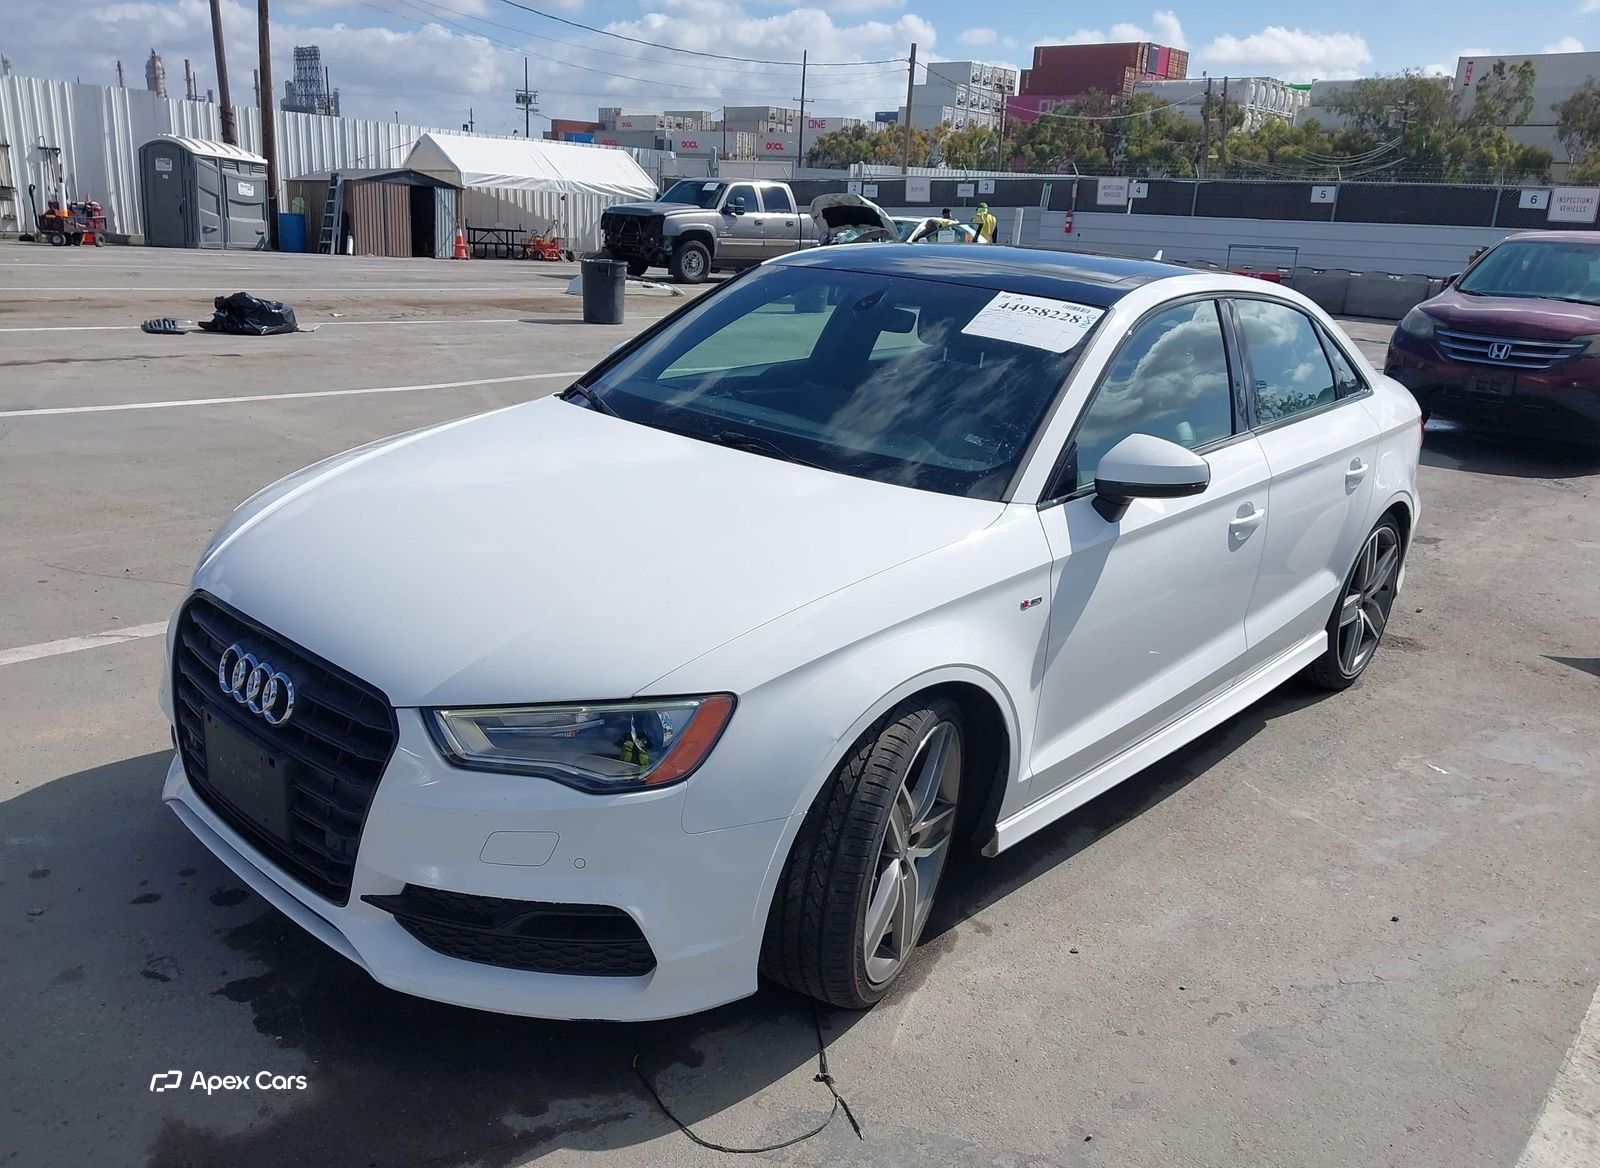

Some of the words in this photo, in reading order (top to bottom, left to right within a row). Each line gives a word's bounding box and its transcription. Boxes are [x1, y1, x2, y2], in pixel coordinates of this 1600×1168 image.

[808, 119, 826, 129] ONE
[681, 140, 698, 148] OOCL
[765, 142, 784, 150] OOCL
[1135, 186, 1141, 194] 4
[1320, 190, 1327, 199] 5
[1530, 195, 1538, 204] 6
[1556, 196, 1594, 204] INSPECTIONS
[998, 303, 1082, 324] 44958228
